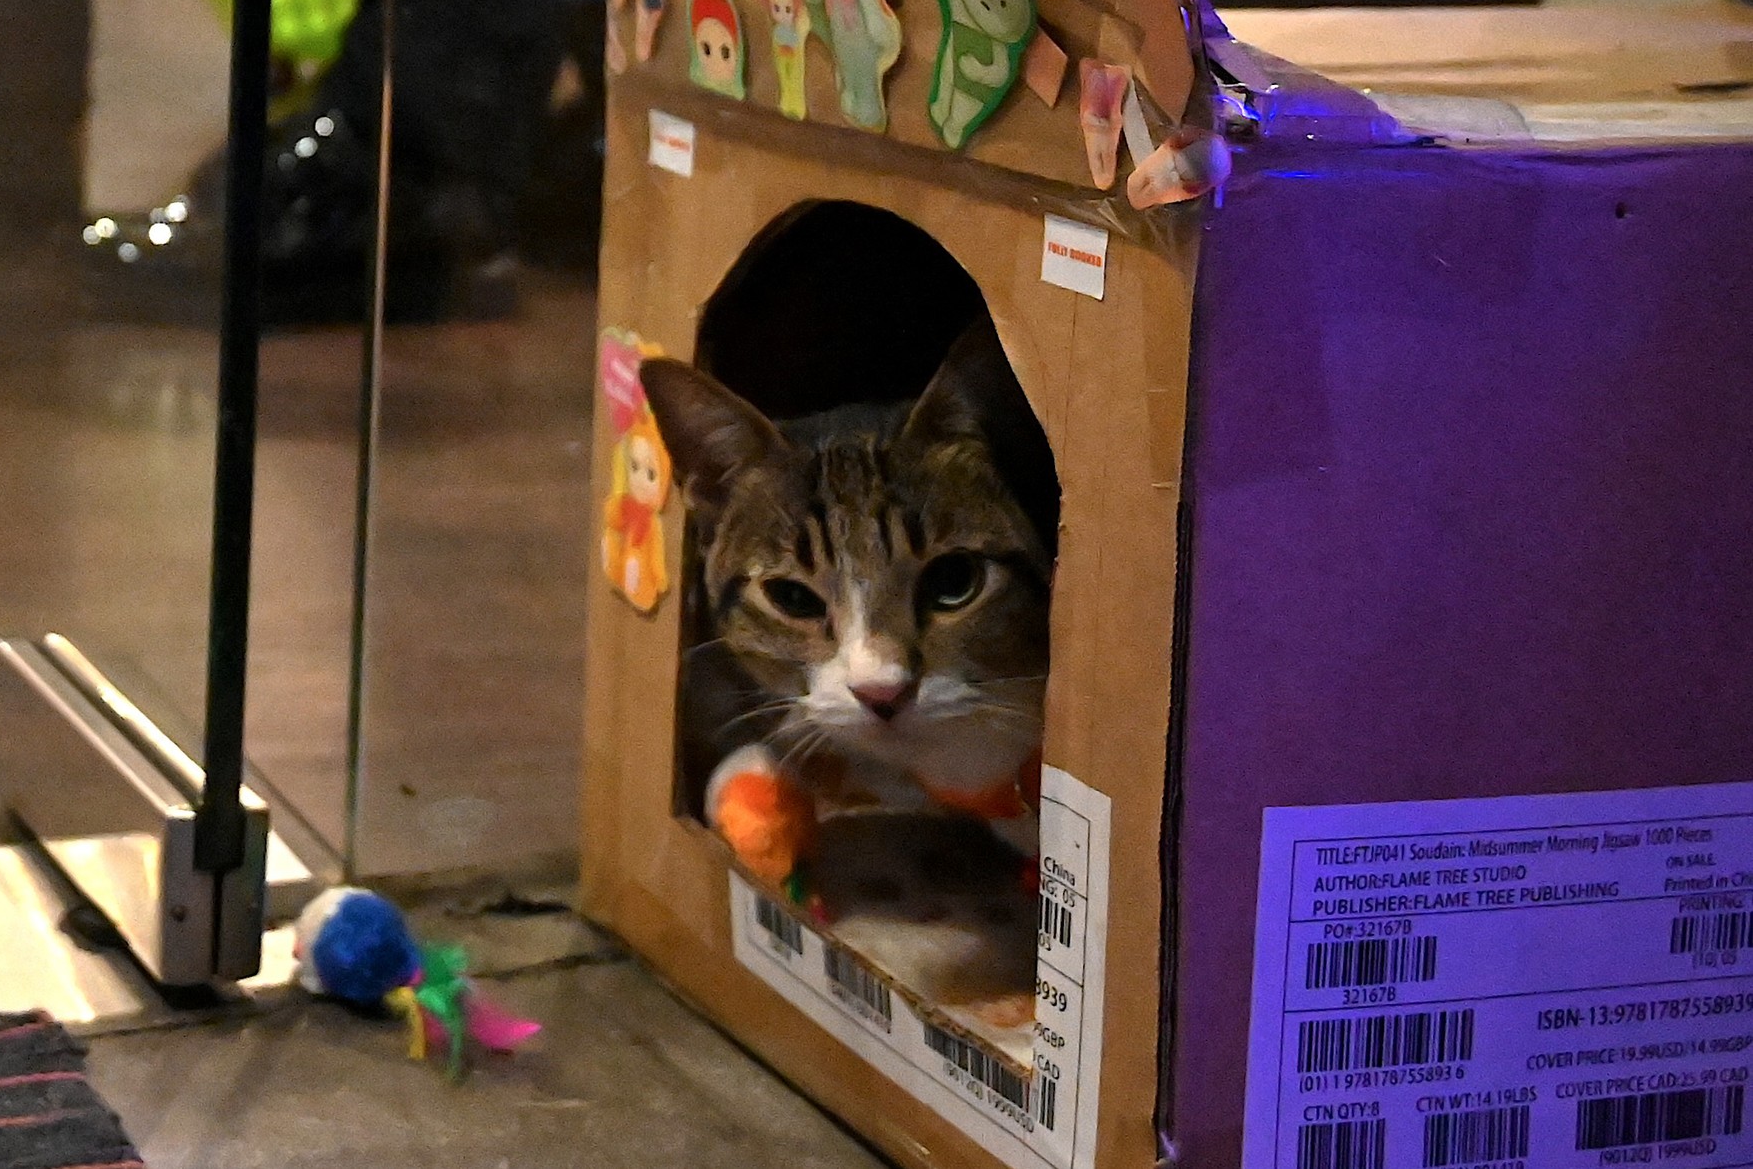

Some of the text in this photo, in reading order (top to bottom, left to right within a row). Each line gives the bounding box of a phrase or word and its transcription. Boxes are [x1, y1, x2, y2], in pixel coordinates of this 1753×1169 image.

[1468, 837, 1544, 858] Midsummer
[1547, 834, 1599, 854] Morning
[1043, 856, 1076, 887] China
[1314, 864, 1527, 893] AUTHOR:FLAME TREE STUDIO
[1312, 881, 1620, 917] PUBLISHER:FLAME TREE PUBLISHING
[1037, 1053, 1061, 1081] CAD
[1526, 1051, 1574, 1071] COVER
[1555, 1081, 1603, 1100] COVER
[1606, 1075, 1645, 1095] PRICE
[1303, 1101, 1380, 1121] CTN QTY:8
[1415, 1095, 1446, 1114] CTN
